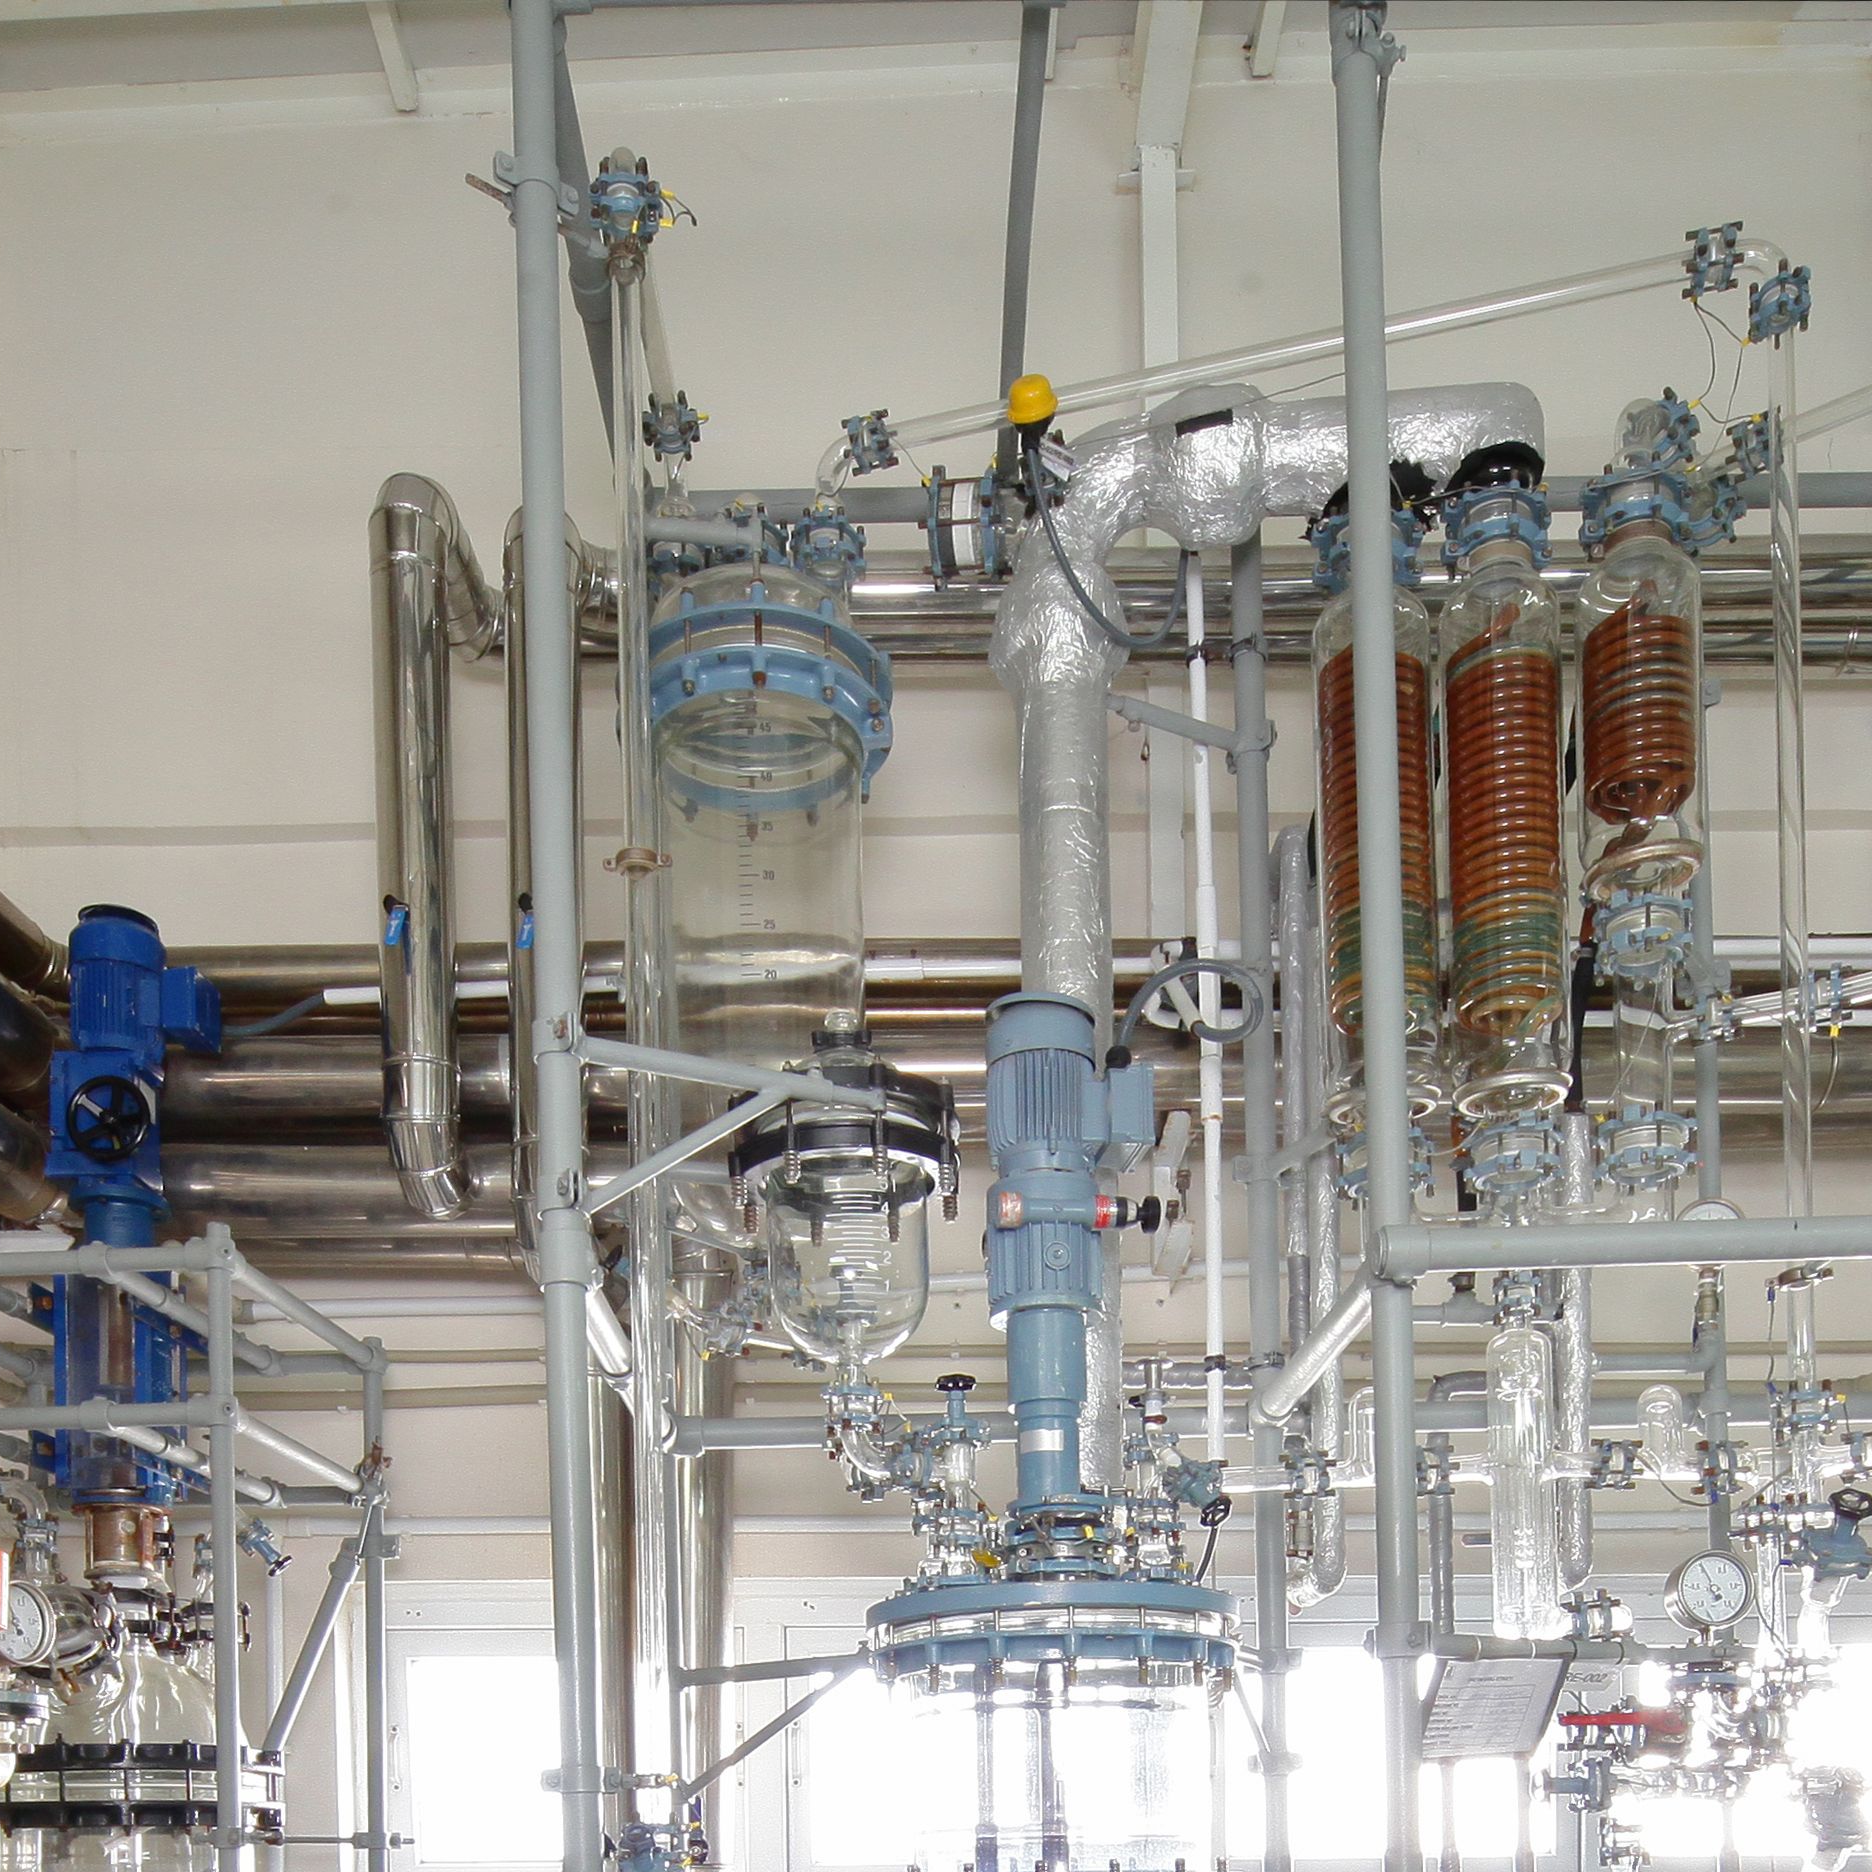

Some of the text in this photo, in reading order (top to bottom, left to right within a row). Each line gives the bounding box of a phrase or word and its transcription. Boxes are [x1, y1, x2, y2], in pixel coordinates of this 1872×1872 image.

[759, 721, 772, 733] 45
[760, 771, 773, 783] 40
[762, 869, 775, 881] 30
[763, 919, 776, 930] 25
[764, 969, 777, 980] 20
[881, 1202, 890, 1215] 4
[881, 1226, 890, 1239] 3
[883, 1251, 892, 1264] 2
